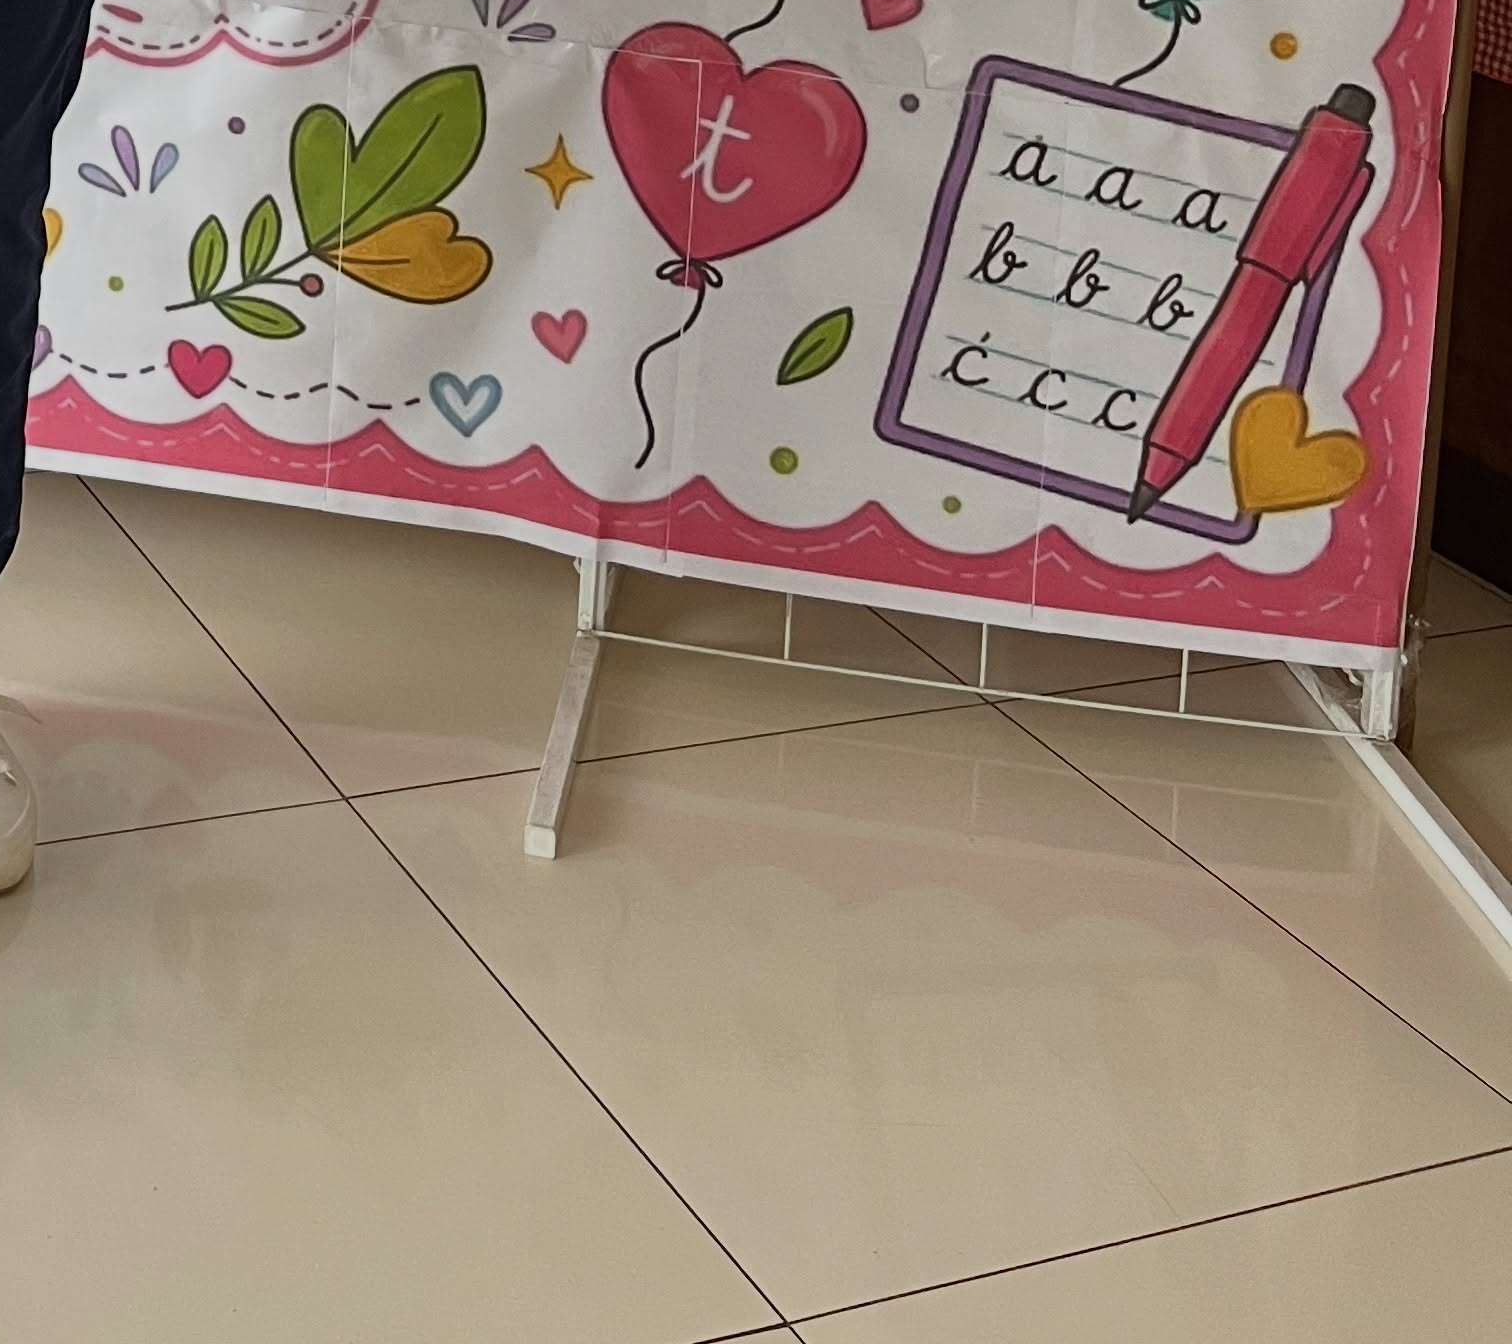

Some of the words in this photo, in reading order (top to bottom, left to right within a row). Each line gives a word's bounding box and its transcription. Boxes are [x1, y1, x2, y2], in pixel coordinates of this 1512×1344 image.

[681, 95, 753, 203] t
[1085, 165, 1143, 211] a
[1172, 188, 1228, 234] a
[969, 222, 1028, 284] b
[1056, 249, 1110, 308] b
[1138, 273, 1194, 331] b
[1019, 368, 1068, 410] c
[1091, 387, 1137, 432] c
